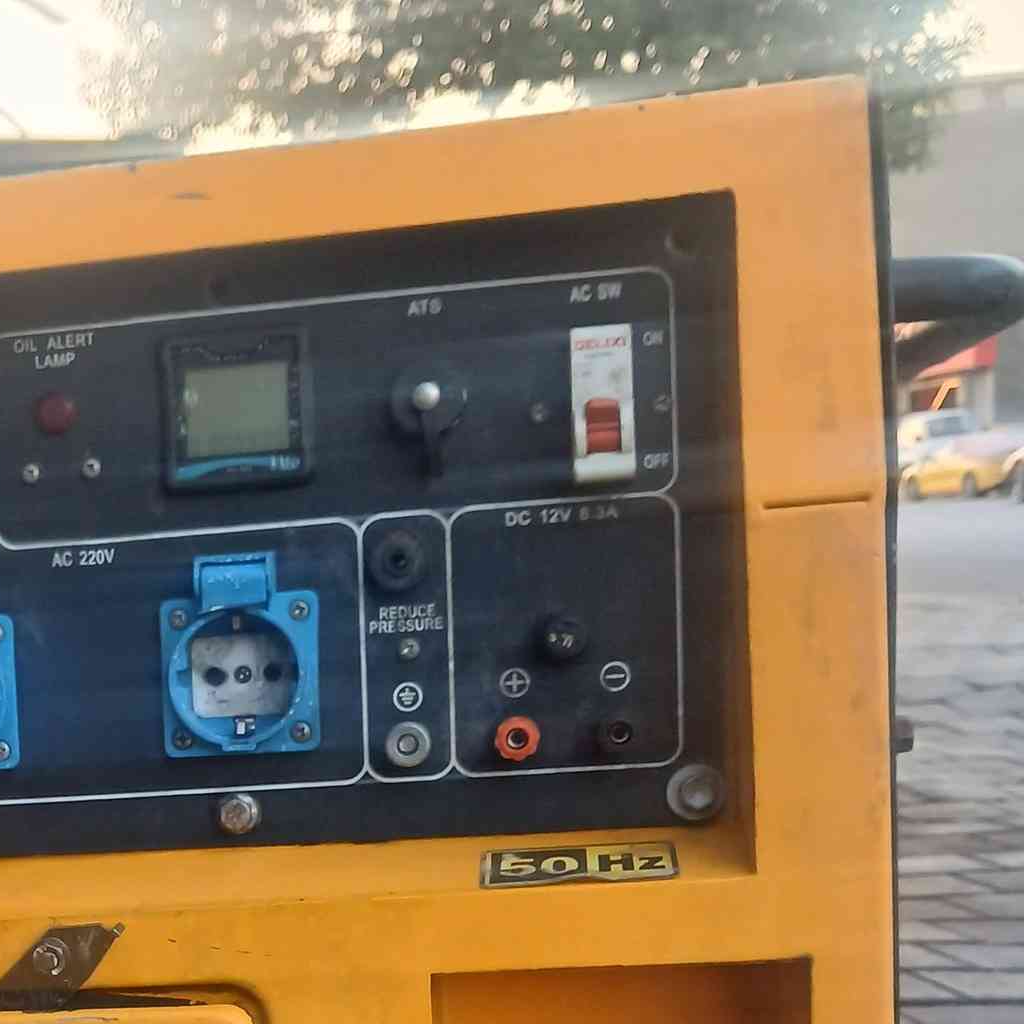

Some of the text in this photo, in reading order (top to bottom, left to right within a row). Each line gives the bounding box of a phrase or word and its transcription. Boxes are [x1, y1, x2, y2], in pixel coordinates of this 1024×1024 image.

[407, 299, 441, 317] ATS
[14, 332, 95, 353] OIL ALERT
[642, 331, 664, 346] ON
[34, 352, 76, 370] LAMP
[643, 453, 670, 470] OFF
[504, 510, 533, 527] DC
[538, 507, 571, 525] 12V
[51, 548, 116, 568] AC 220V
[378, 603, 436, 621] REDUCE
[369, 616, 445, 635] PRESSURE
[499, 851, 667, 878] 50 Hz
